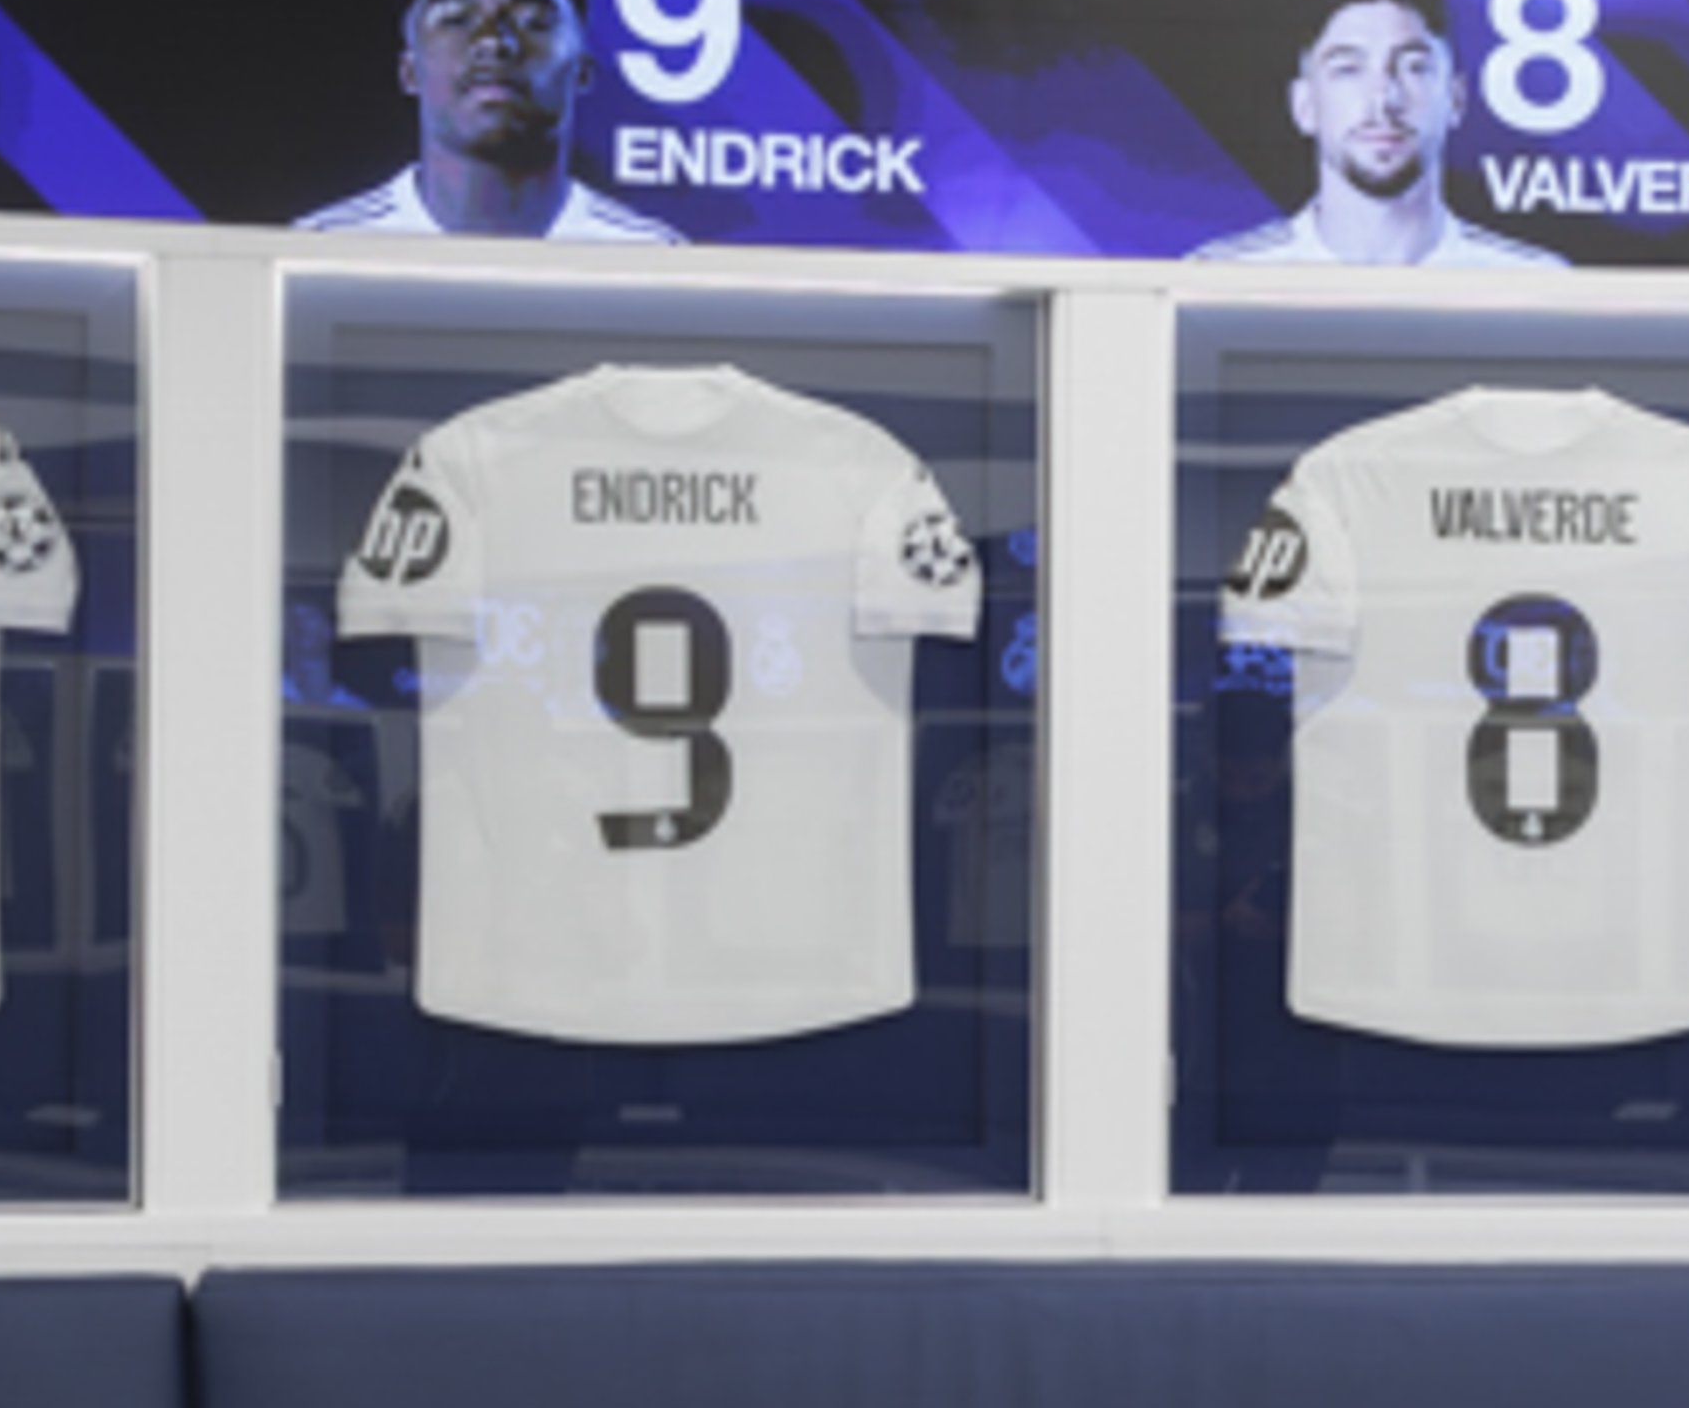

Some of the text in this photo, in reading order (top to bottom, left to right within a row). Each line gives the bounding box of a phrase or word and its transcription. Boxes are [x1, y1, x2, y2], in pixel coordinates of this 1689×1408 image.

[613, 127, 927, 193] ENDRICK
[572, 469, 761, 525] ENDRICK
[1429, 488, 1640, 546] VALVERDE
[592, 583, 733, 852] 9
[1465, 592, 1600, 848] 8
